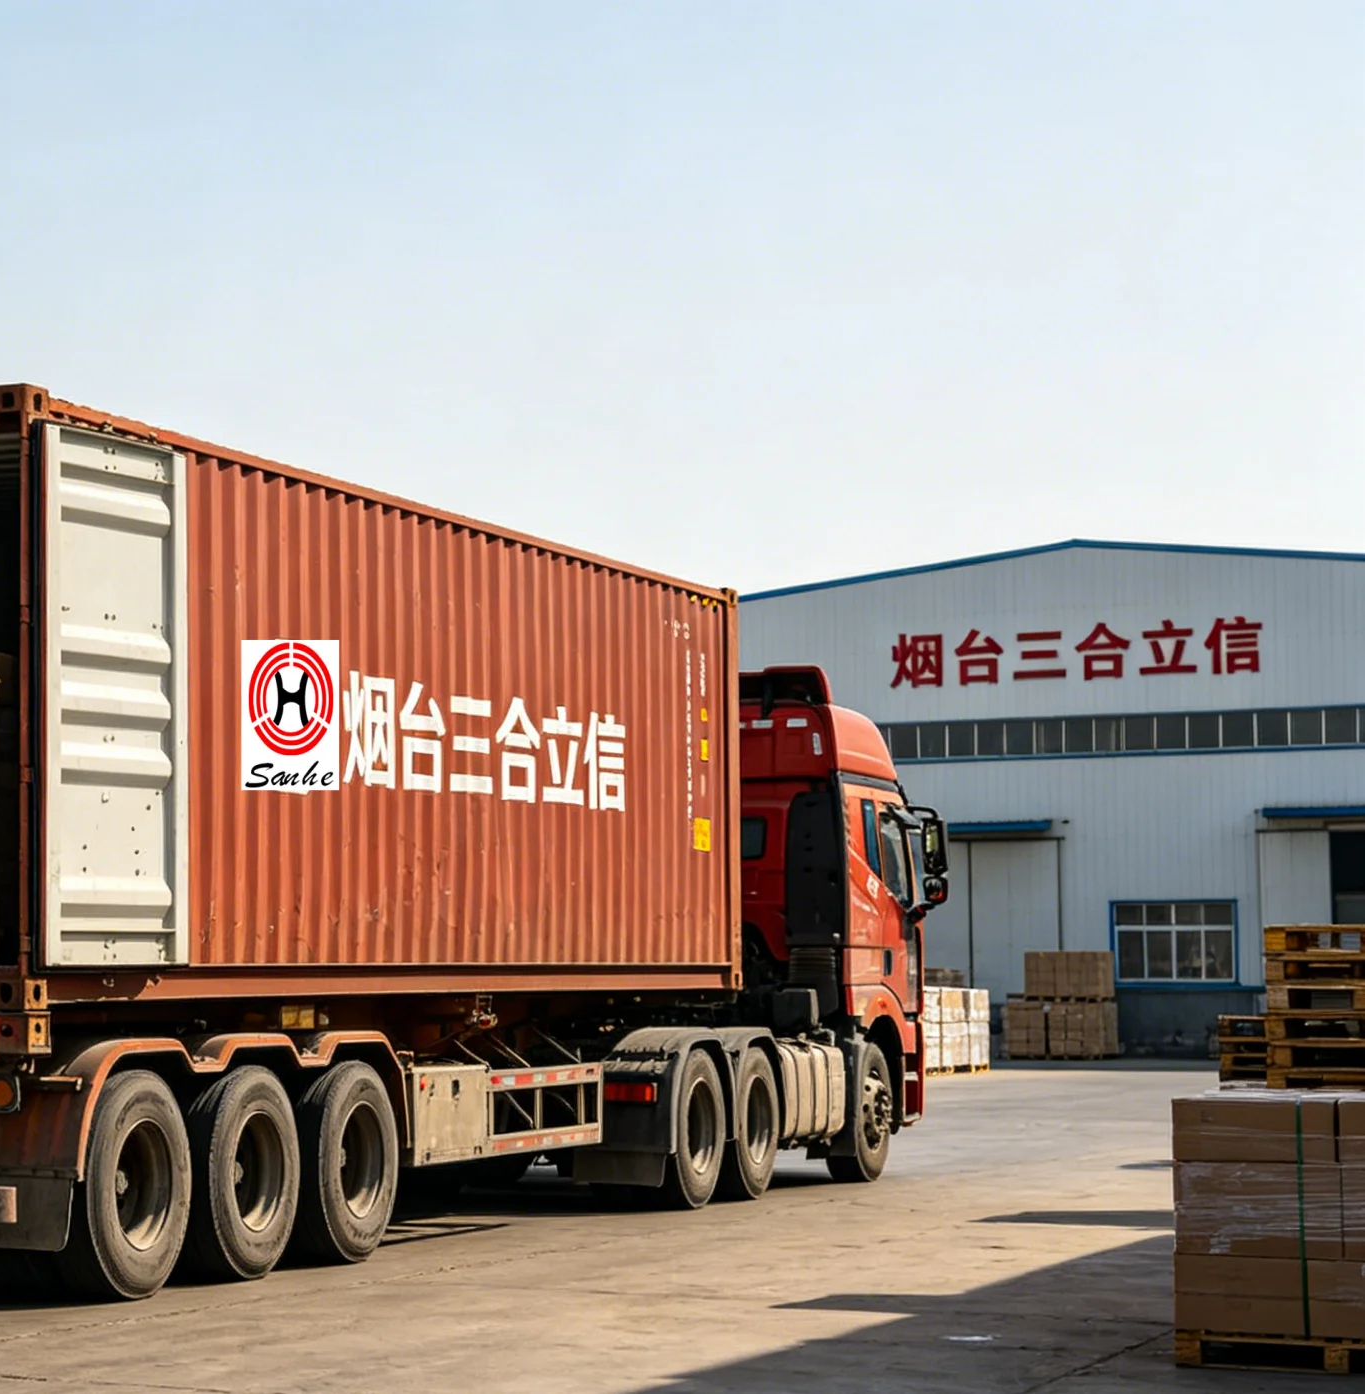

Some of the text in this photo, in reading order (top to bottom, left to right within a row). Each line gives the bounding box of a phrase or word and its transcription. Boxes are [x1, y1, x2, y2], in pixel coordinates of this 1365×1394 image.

[890, 616, 1263, 689] 烟台三合立信
[342, 670, 626, 812] 烟台三合立信
